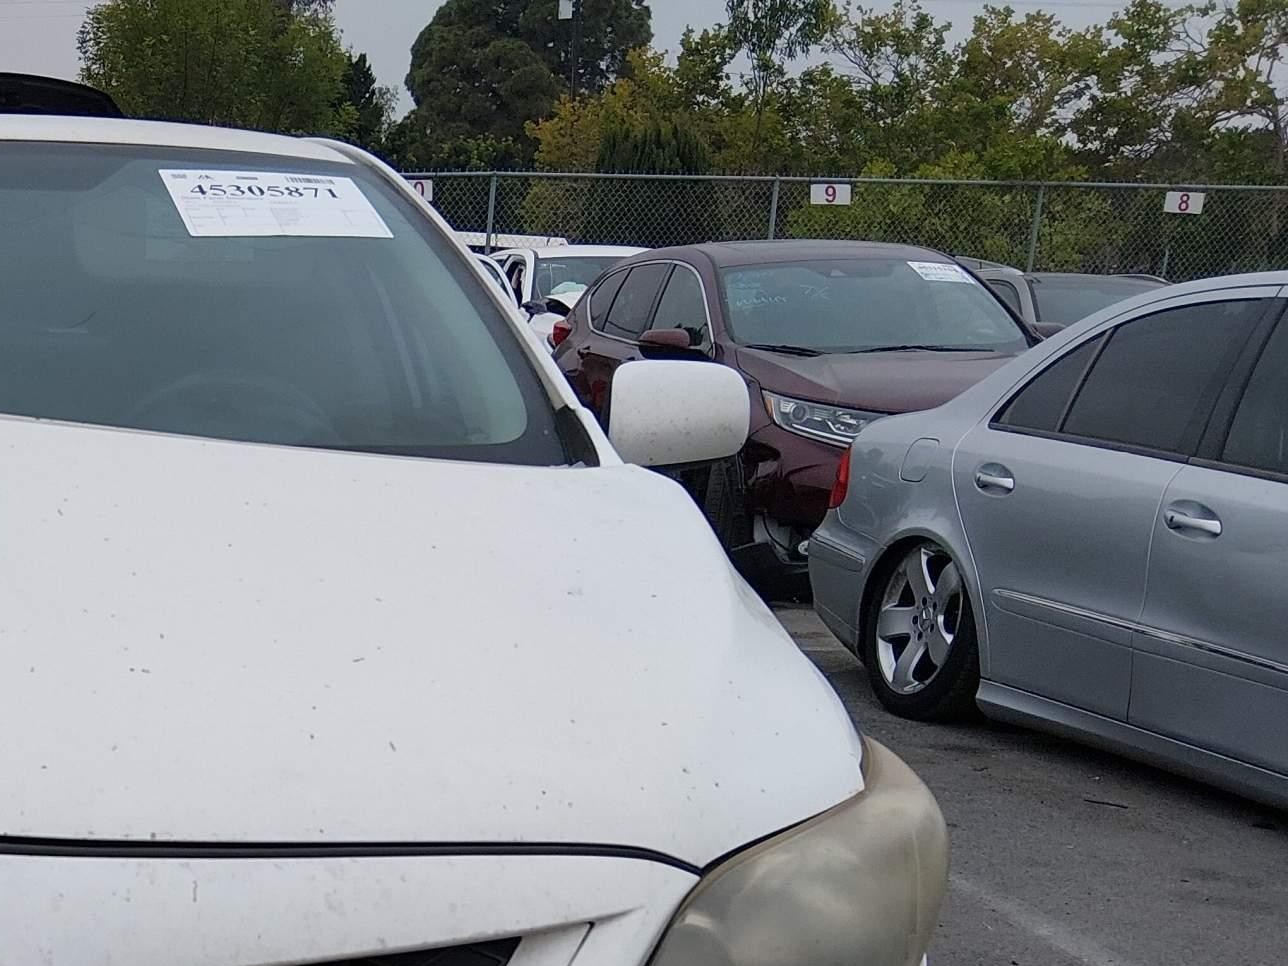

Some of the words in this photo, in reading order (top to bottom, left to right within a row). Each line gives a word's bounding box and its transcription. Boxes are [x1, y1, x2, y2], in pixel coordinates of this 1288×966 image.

[190, 184, 339, 199] 45305871
[825, 185, 837, 203] 9
[1178, 193, 1190, 211] 8
